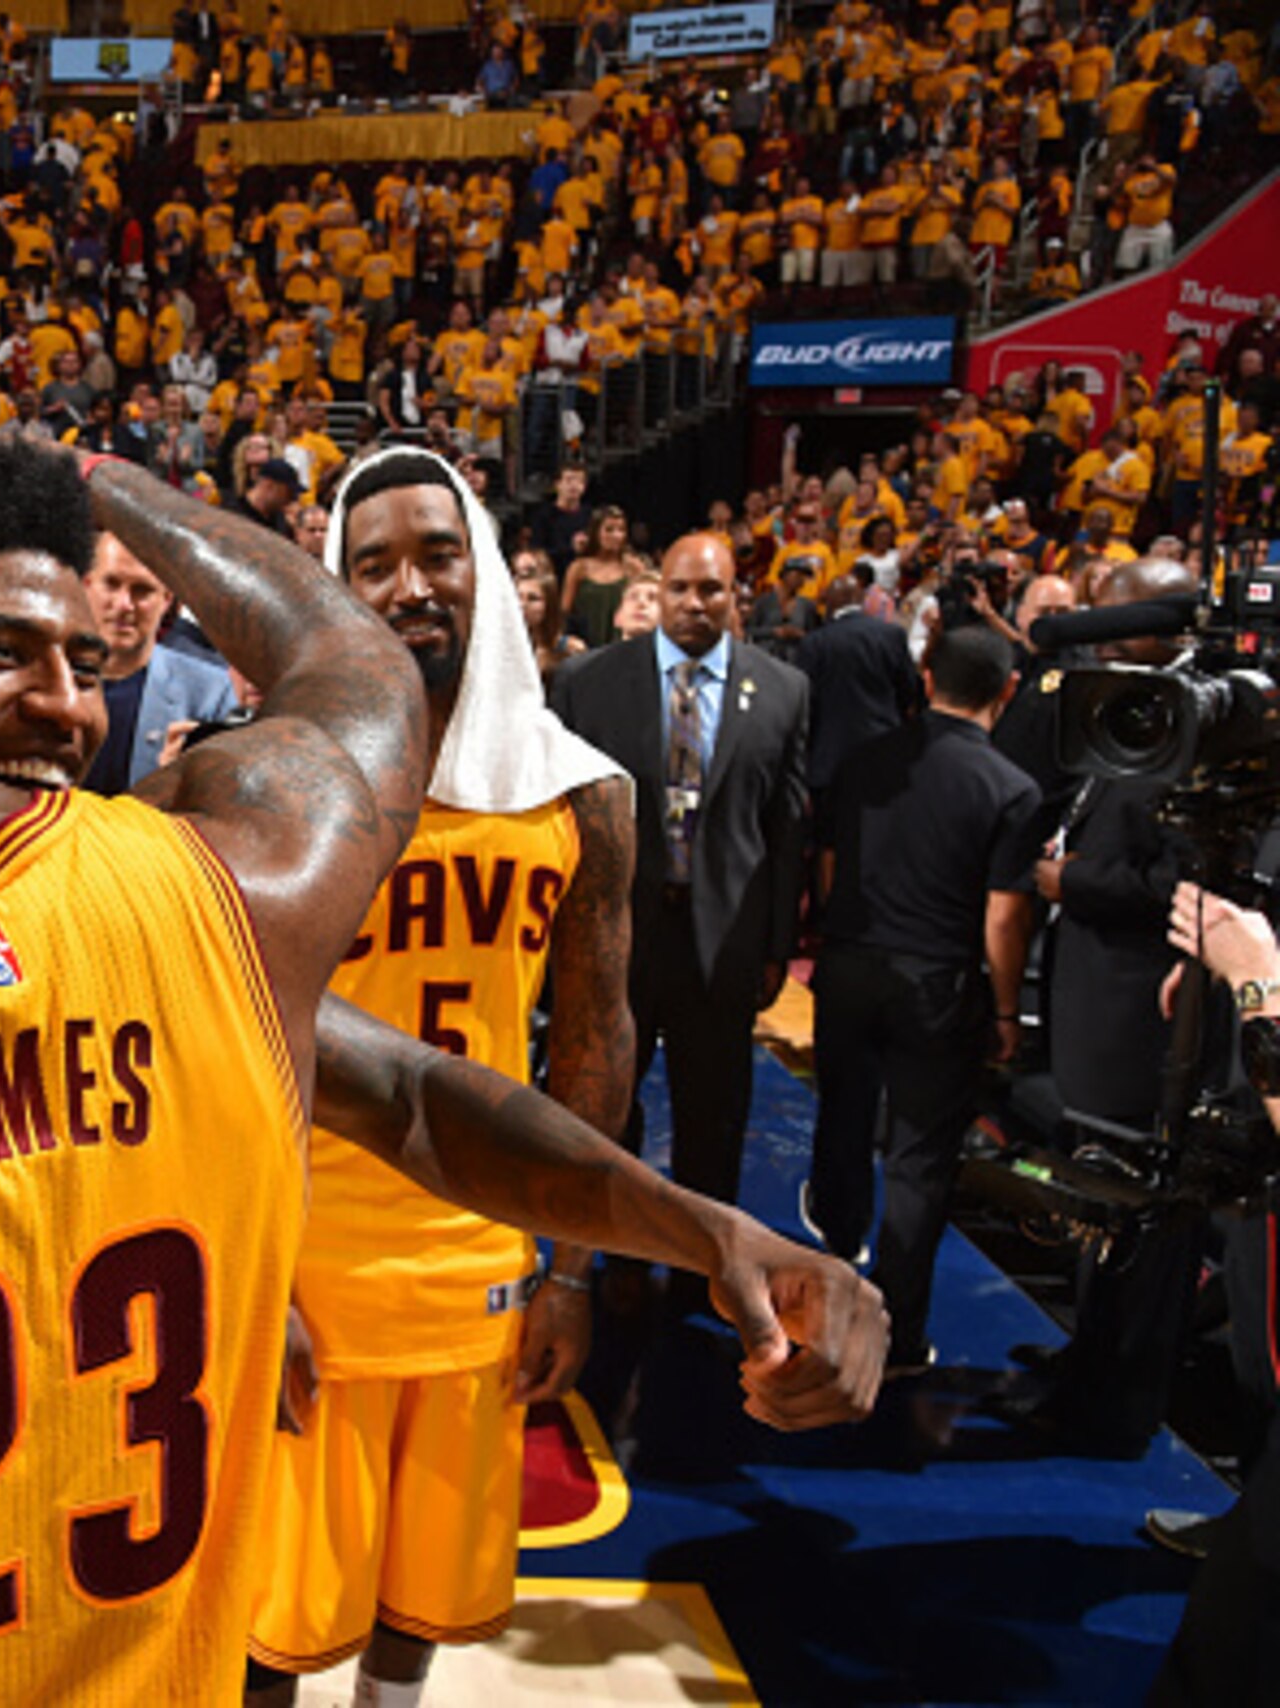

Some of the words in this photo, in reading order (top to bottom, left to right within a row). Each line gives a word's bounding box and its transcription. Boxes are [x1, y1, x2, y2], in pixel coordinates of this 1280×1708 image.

[754, 343, 832, 366] BUD
[843, 338, 953, 365] LIGHT
[341, 855, 564, 963] AVS
